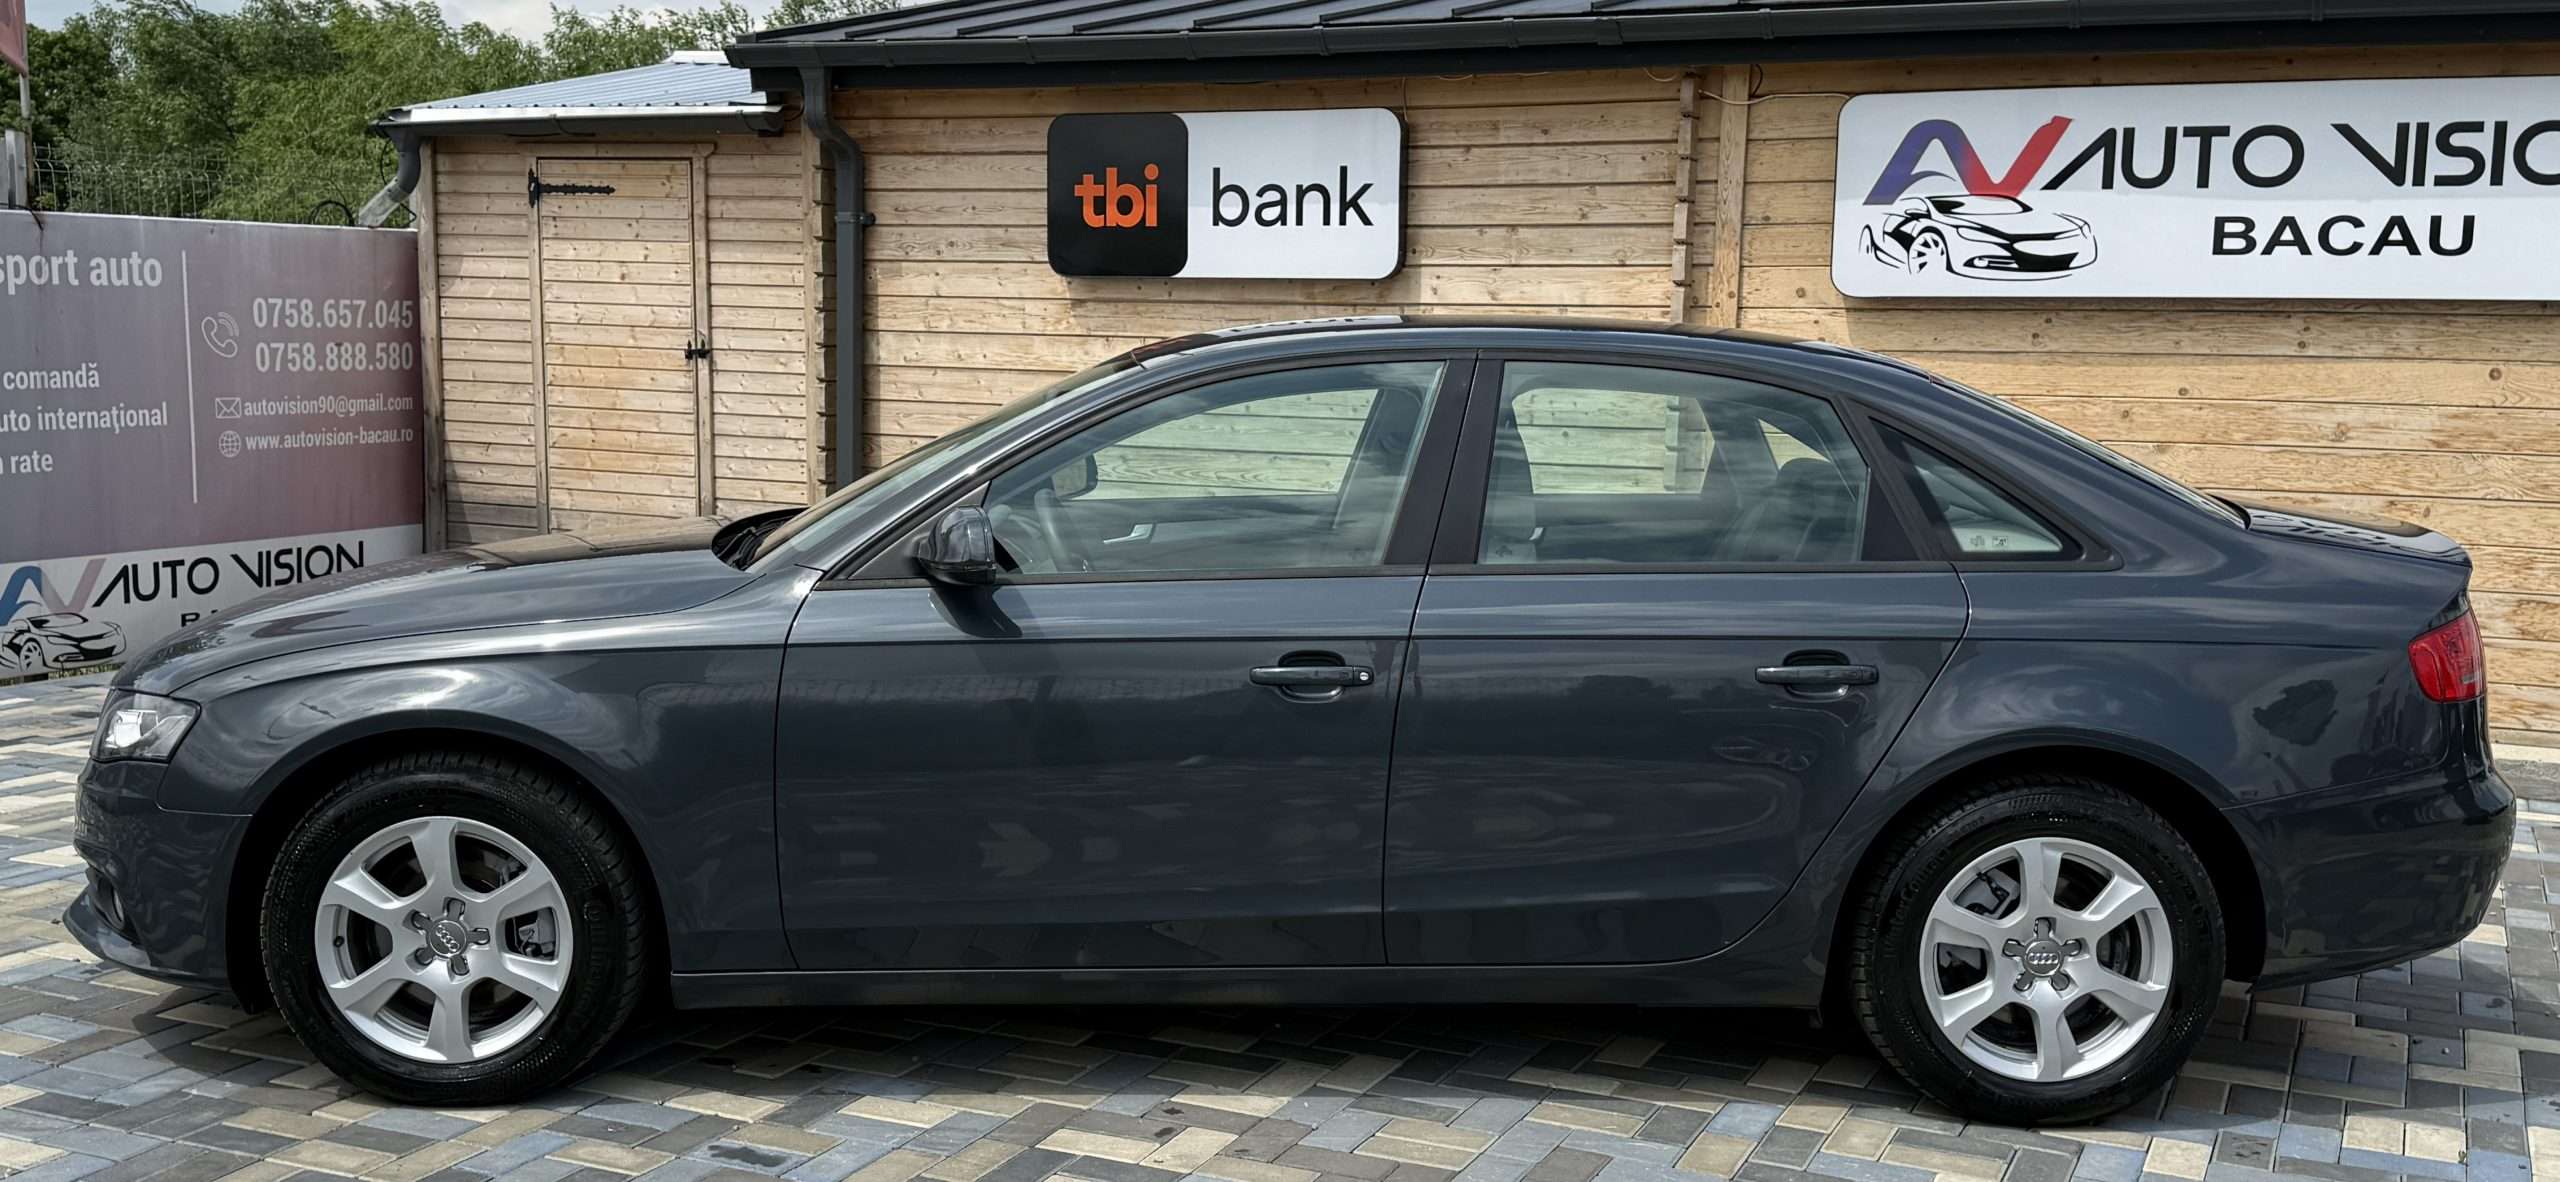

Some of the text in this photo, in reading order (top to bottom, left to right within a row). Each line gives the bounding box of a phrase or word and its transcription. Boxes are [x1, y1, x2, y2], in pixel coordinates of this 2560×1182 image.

[2041, 125, 2305, 190] AUTO
[1074, 163, 1375, 228] tbi bank
[2212, 215, 2475, 257] BACAU
[89, 251, 162, 287] auto
[253, 297, 413, 329] 0758.657.045
[255, 342, 413, 373] 0758.888.580
[3, 362, 100, 390] comandă
[244, 393, 414, 418] autovision90@gmail.com
[245, 426, 414, 450] www.autovision-bacau.ro
[10, 451, 53, 474] rate
[92, 556, 219, 608] AUTO
[230, 540, 364, 588] VISION
